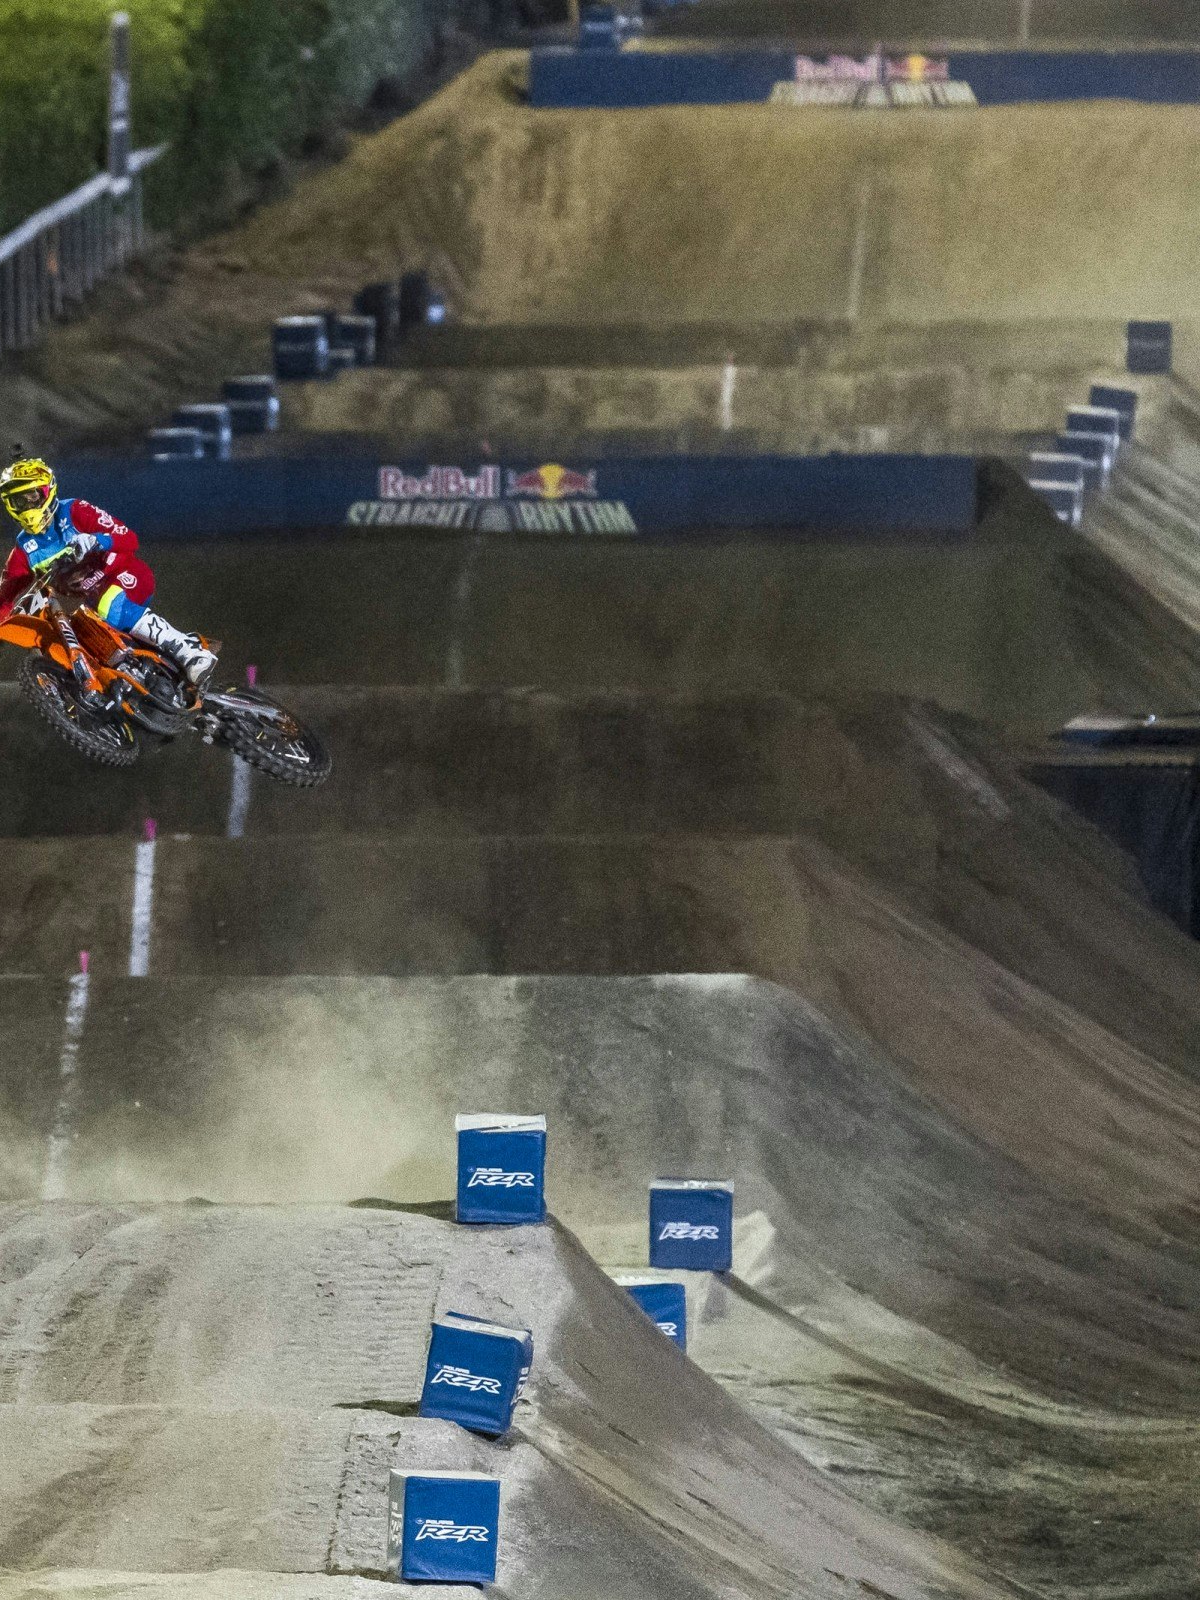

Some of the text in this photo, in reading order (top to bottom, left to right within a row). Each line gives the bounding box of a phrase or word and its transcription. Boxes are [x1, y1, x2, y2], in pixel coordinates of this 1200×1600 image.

[379, 465, 501, 499] Red Bull
[346, 500, 638, 534] STRAIGHT RHYTHM
[467, 1172, 535, 1188] RZR
[659, 1225, 720, 1241] RZR
[430, 1368, 502, 1395] RZR
[415, 1523, 490, 1544] RZR
